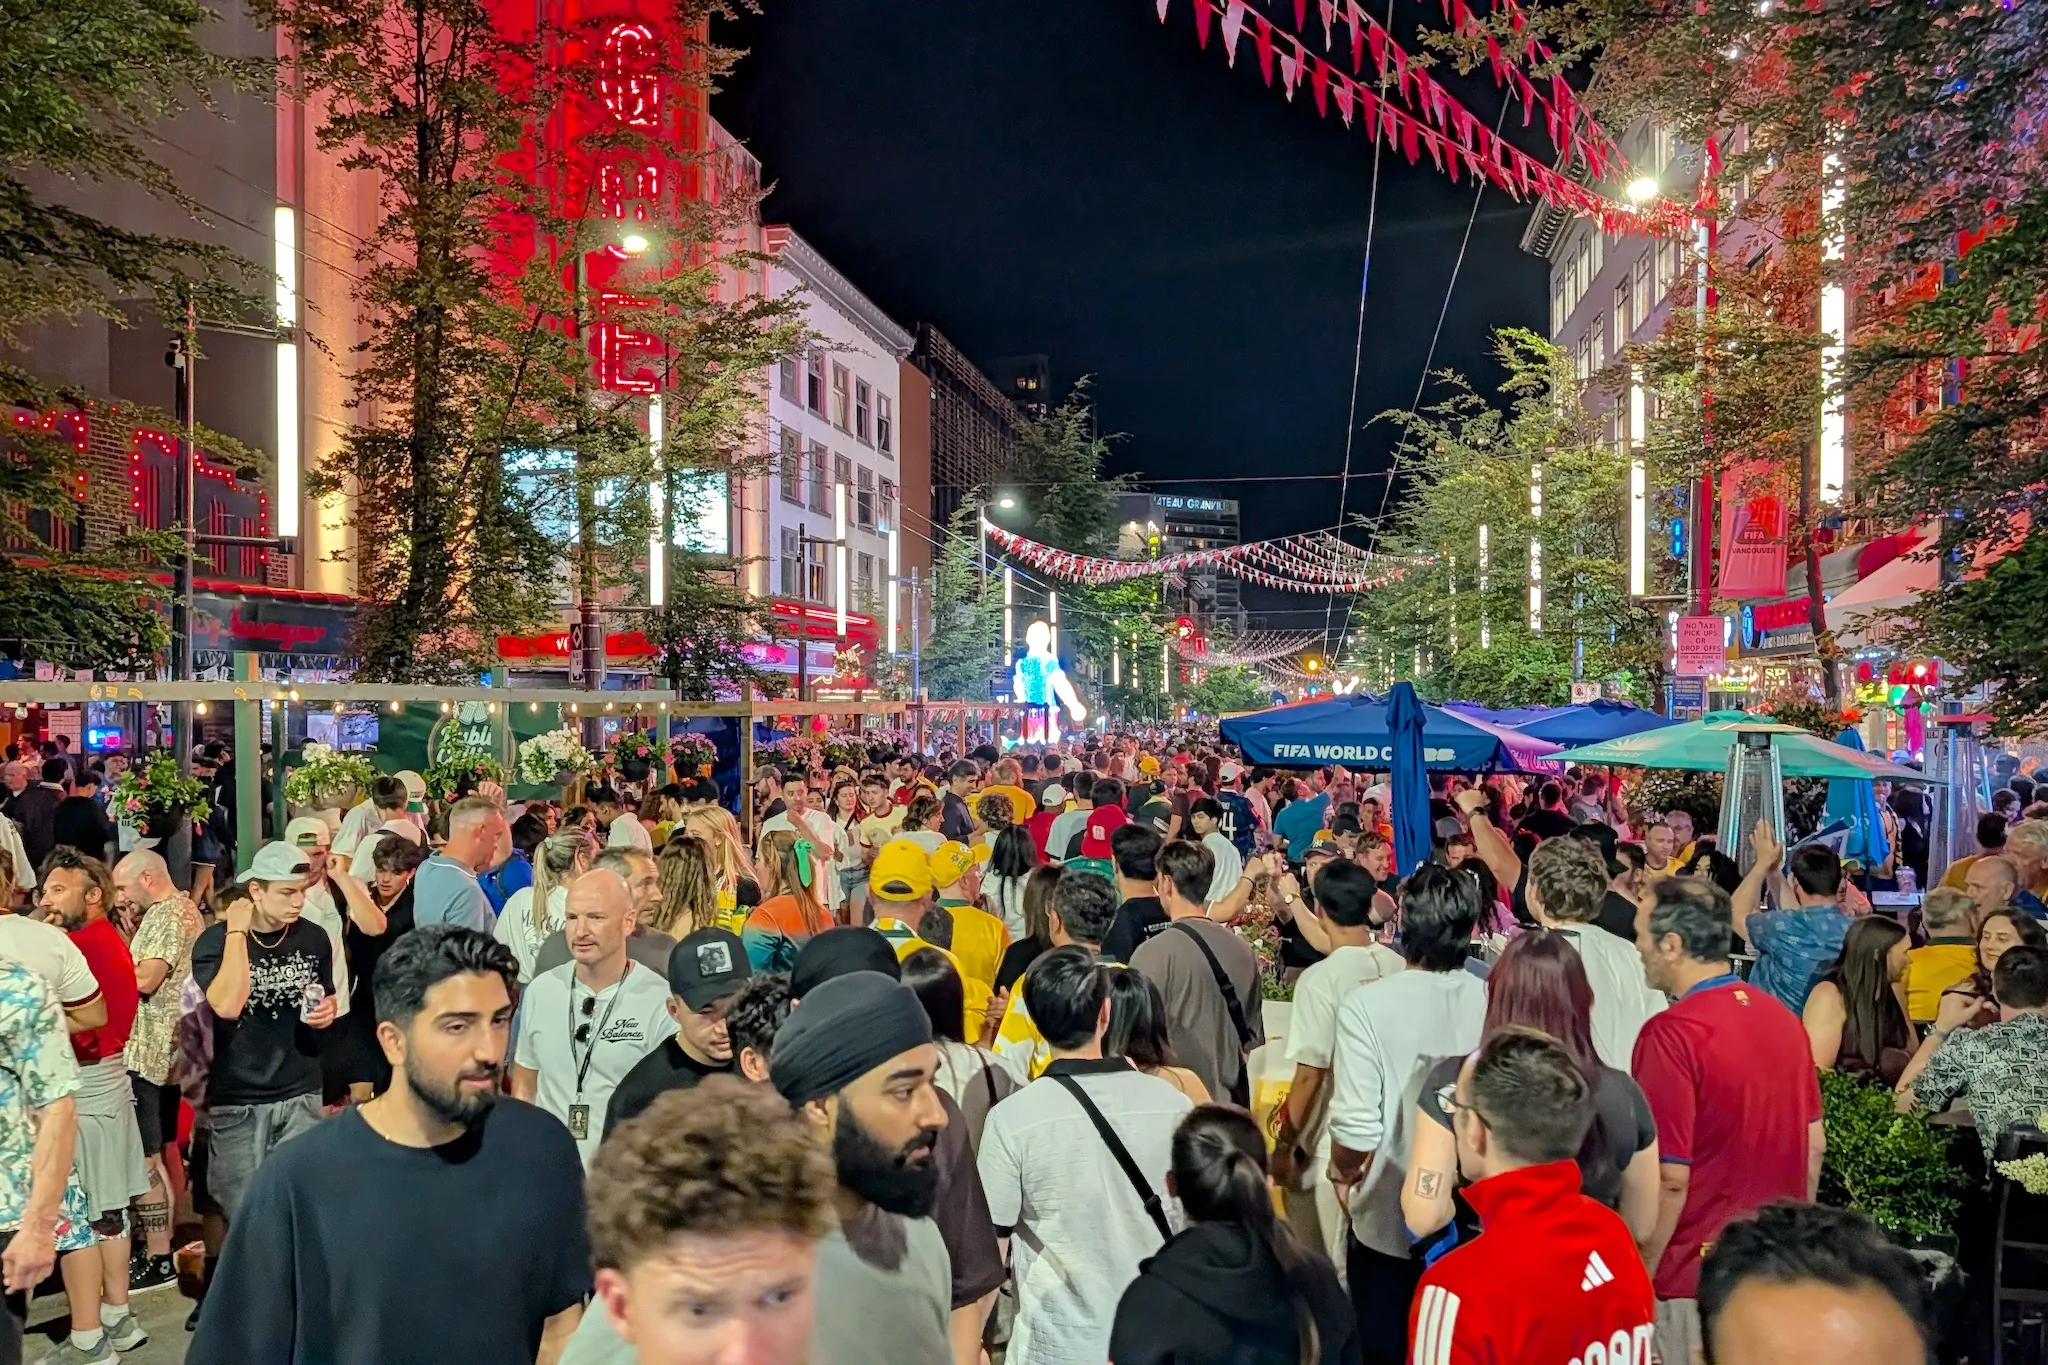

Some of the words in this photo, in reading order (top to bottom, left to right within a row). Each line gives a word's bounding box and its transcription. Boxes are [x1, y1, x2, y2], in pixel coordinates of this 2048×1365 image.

[1154, 496, 1183, 509] ATEAU
[1187, 498, 1232, 512] GRANVIL
[1744, 531, 1765, 540] FIFA
[1686, 622, 1697, 630] NO
[1700, 622, 1716, 630] TAXI
[1273, 743, 1312, 758] FIFA
[1313, 745, 1379, 760] WORLD
[613, 1018, 639, 1030] New
[600, 1029, 644, 1041] Balance
